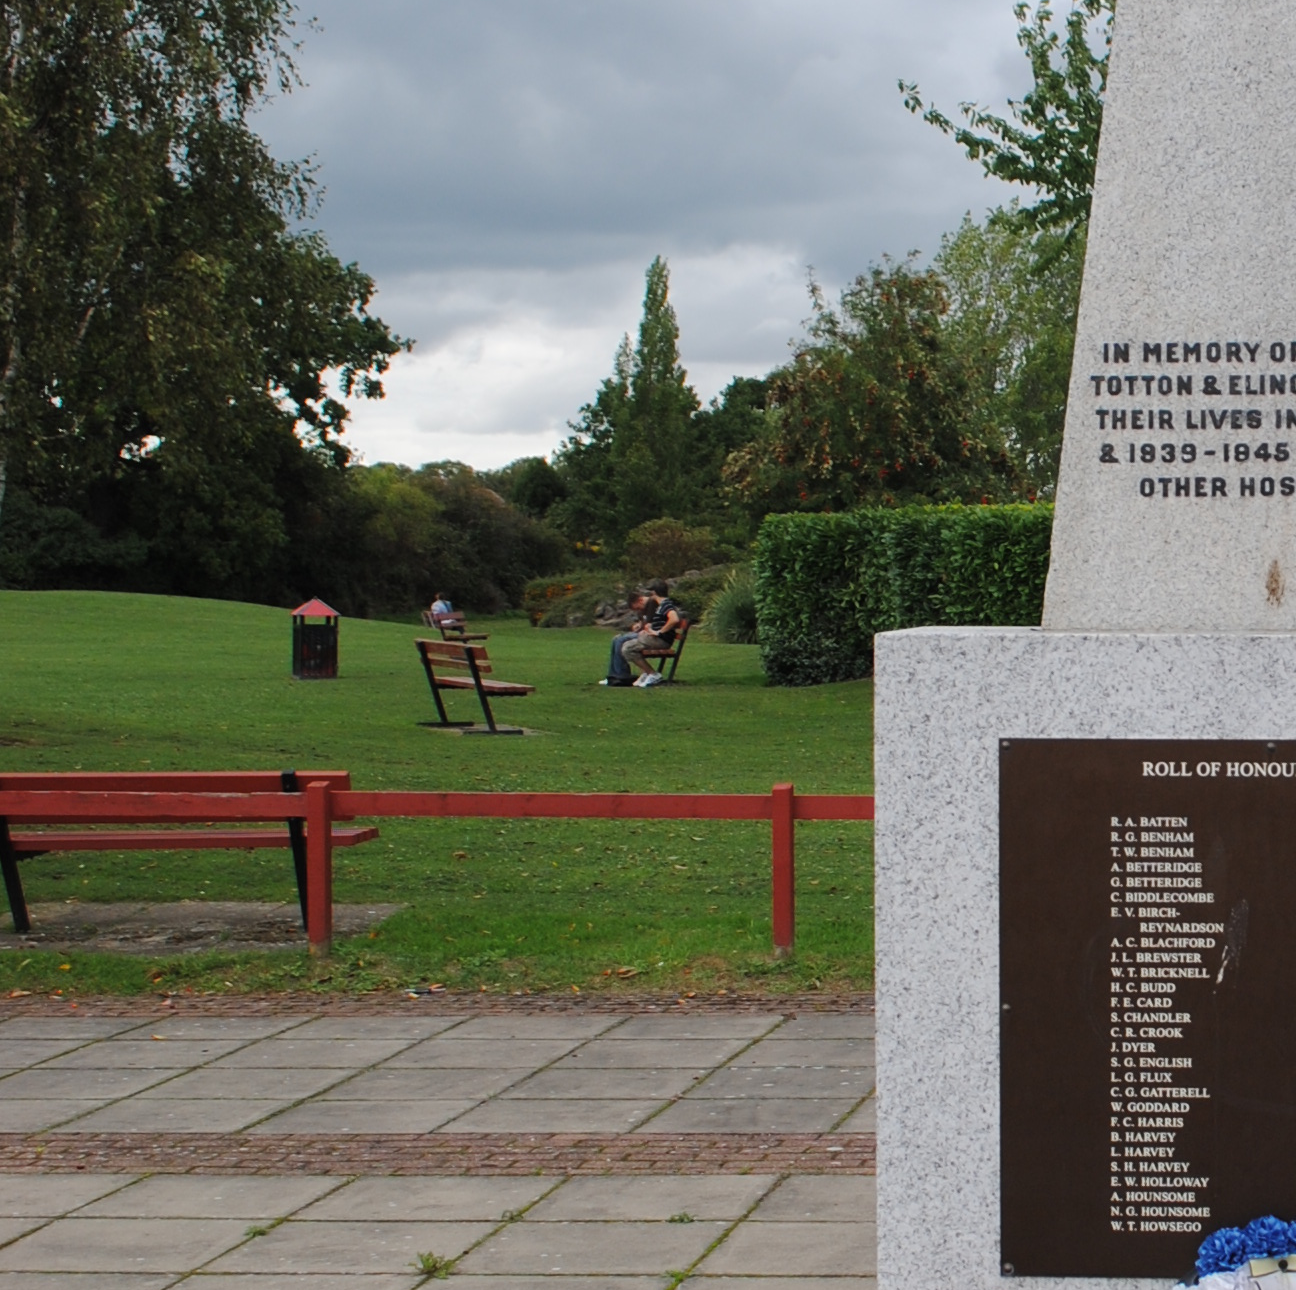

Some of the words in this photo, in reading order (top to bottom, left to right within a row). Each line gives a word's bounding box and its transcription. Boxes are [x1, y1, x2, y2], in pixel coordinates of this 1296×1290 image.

[1103, 343, 1130, 364] IN
[1143, 342, 1260, 363] MEMORY
[1090, 375, 1192, 396] TOTTON
[1202, 375, 1222, 396] &
[1095, 409, 1174, 430] THEIR
[1186, 409, 1262, 430] LIVES
[1099, 443, 1119, 463] &
[1140, 477, 1228, 498] OTHER
[1142, 761, 1192, 777] ROLL
[1196, 762, 1221, 777] OF
[1111, 816, 1122, 827] R.
[1124, 817, 1137, 827] A.
[1140, 817, 1187, 827] BATTEN
[1111, 832, 1122, 842] R.
[1125, 832, 1137, 842] G.
[1141, 832, 1194, 842] BENHAM
[1110, 862, 1123, 872] A.
[1126, 862, 1202, 873] BETTERIDGE
[1110, 877, 1123, 887] G.
[1126, 877, 1202, 888] BETTERIDGE
[1110, 892, 1122, 902] C.
[1125, 892, 1214, 903] BIDDLECOMBE
[1111, 907, 1122, 917] E.
[1124, 907, 1135, 917] V.
[1138, 907, 1180, 918] BIRCH-
[1140, 922, 1224, 933] REYNARDSON
[1111, 938, 1123, 947] A.
[1126, 937, 1138, 947] C.
[1141, 937, 1216, 948] BLACHFORD
[1111, 967, 1124, 977] W.
[1127, 967, 1137, 977] T.
[1140, 967, 1210, 978] BRICKNELL
[1111, 982, 1123, 992] H.
[1125, 982, 1138, 993] C.
[1140, 982, 1176, 993] BUDD
[1111, 1012, 1121, 1022] S.
[1124, 1012, 1191, 1023] CHANDLER
[1110, 1027, 1122, 1037] C.
[1125, 1027, 1137, 1037] R.
[1139, 1027, 1183, 1038] CROOK
[1110, 1042, 1119, 1052] J.
[1122, 1042, 1156, 1053] DYER
[1111, 1072, 1122, 1082] L.
[1124, 1072, 1137, 1082] G.
[1140, 1072, 1172, 1083] FLUX
[1110, 1087, 1122, 1097] C.
[1125, 1087, 1138, 1097] G.
[1140, 1087, 1210, 1098] GATTERELL
[1111, 1102, 1124, 1112] W.
[1127, 1102, 1190, 1113] GODDARD
[1111, 1131, 1122, 1142] B.
[1125, 1132, 1176, 1142] HARVEY
[1111, 1147, 1121, 1157] L.
[1124, 1147, 1175, 1157] HARVEY
[1111, 1161, 1121, 1172] S.
[1124, 1162, 1136, 1172] H.
[1139, 1162, 1190, 1172] HARVEY
[1111, 1176, 1121, 1187] E.
[1124, 1176, 1138, 1187] W.
[1141, 1177, 1209, 1187] HOLLOWAY
[1110, 1192, 1123, 1201] A.
[1126, 1191, 1195, 1202] HOUNSOME
[1111, 1221, 1124, 1231] W.
[1127, 1221, 1137, 1231] T.
[1140, 1221, 1202, 1232] HOWSEGO
